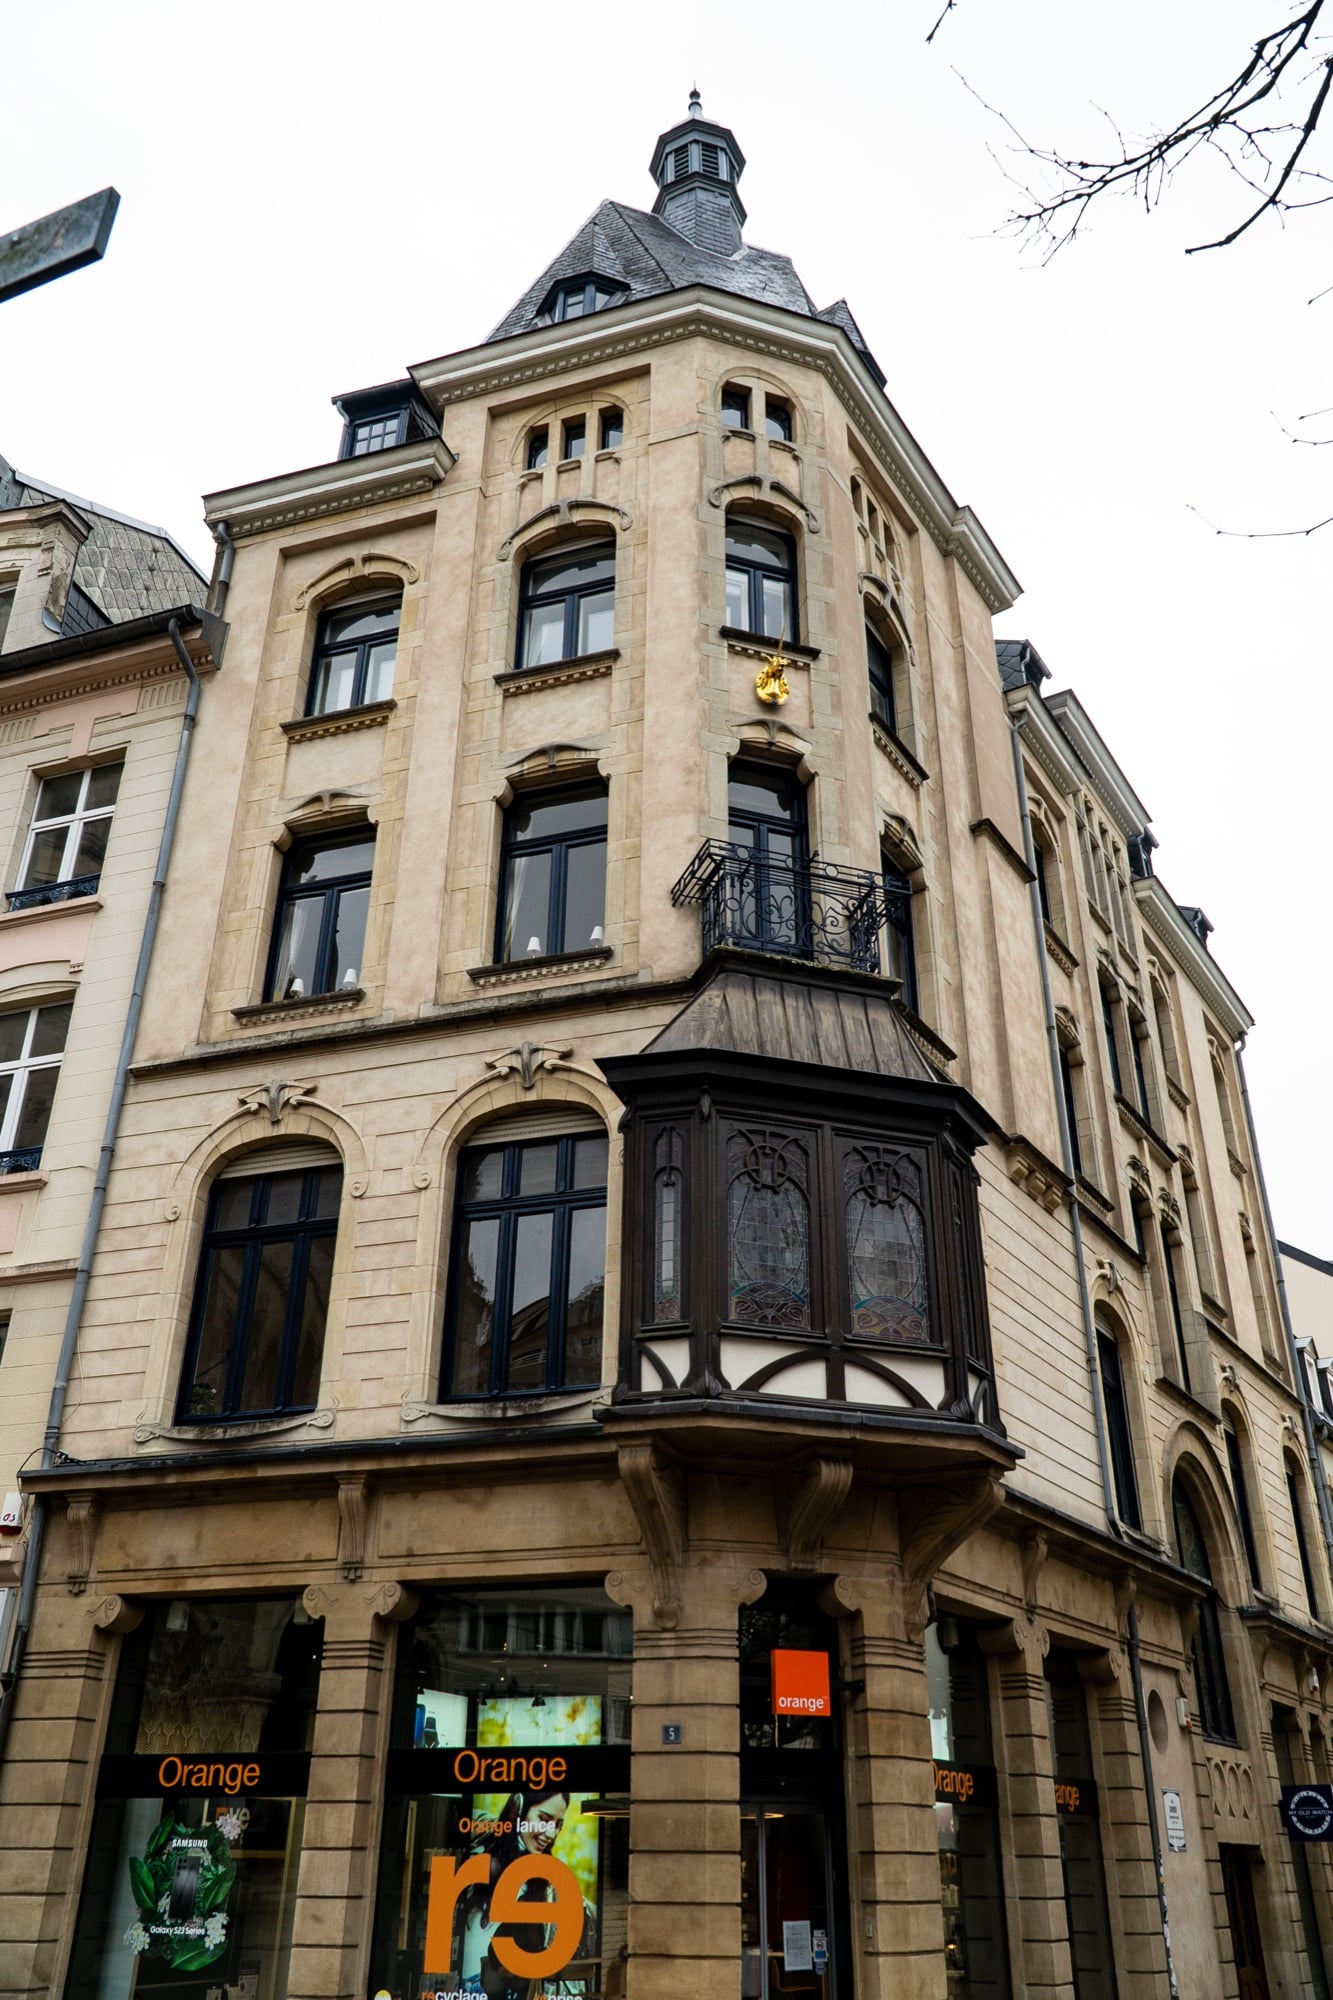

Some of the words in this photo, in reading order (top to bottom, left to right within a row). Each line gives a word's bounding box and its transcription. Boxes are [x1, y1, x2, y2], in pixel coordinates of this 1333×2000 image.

[778, 1696, 824, 1712] orange
[668, 1727, 675, 1740] 5
[158, 1756, 261, 1795] Orange
[454, 1750, 567, 1790] Orange
[1055, 1784, 1080, 1811] ange
[458, 1817, 513, 1837] Orange
[516, 1816, 557, 1833] lance
[172, 1838, 208, 1848] SAMSUNG
[150, 1925, 173, 1936] Galaxy
[173, 1926, 185, 1935] S23
[185, 1926, 206, 1936] Series
